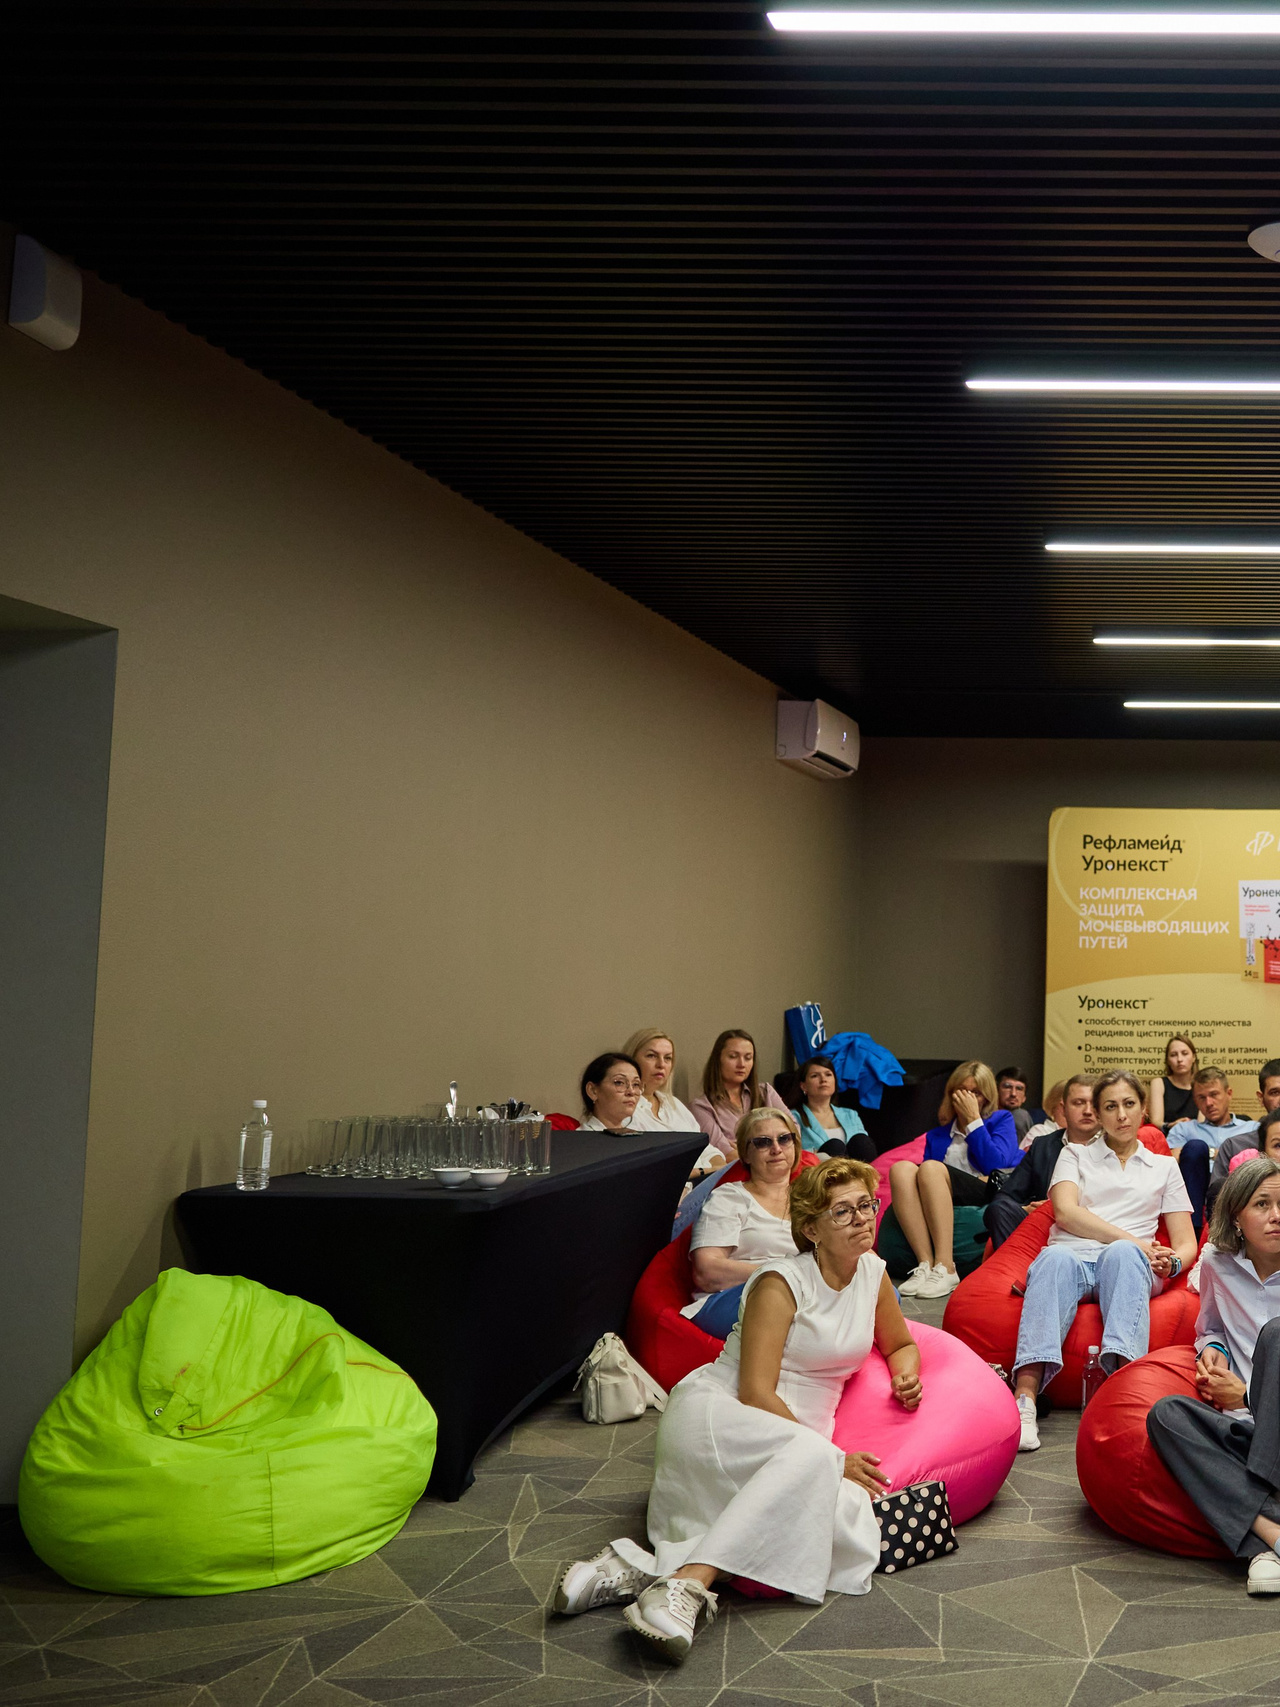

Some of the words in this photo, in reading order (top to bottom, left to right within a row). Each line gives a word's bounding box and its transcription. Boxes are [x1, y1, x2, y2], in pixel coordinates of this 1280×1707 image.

[1081, 855, 1169, 874] Уронекст
[1079, 886, 1198, 901] КОМПЛЕКСНАЯ
[1079, 903, 1145, 917] ЗАЩИТА
[1079, 920, 1230, 935] МОЧЕВЫВОДЯЩИХ
[1078, 935, 1128, 949] ПУТЕЙ
[1078, 995, 1149, 1011] Уронекст
[1084, 1017, 1146, 1027] способствует
[1148, 1018, 1197, 1027] снижению
[1199, 1019, 1252, 1027] количества
[1084, 1028, 1134, 1038] рецидивов
[1136, 1029, 1174, 1038] цистита
[1183, 1029, 1189, 1037] 4
[1084, 1043, 1135, 1054] D-манноза,
[1097, 1057, 1161, 1066] препятствуют
[1212, 1057, 1227, 1065] coli
